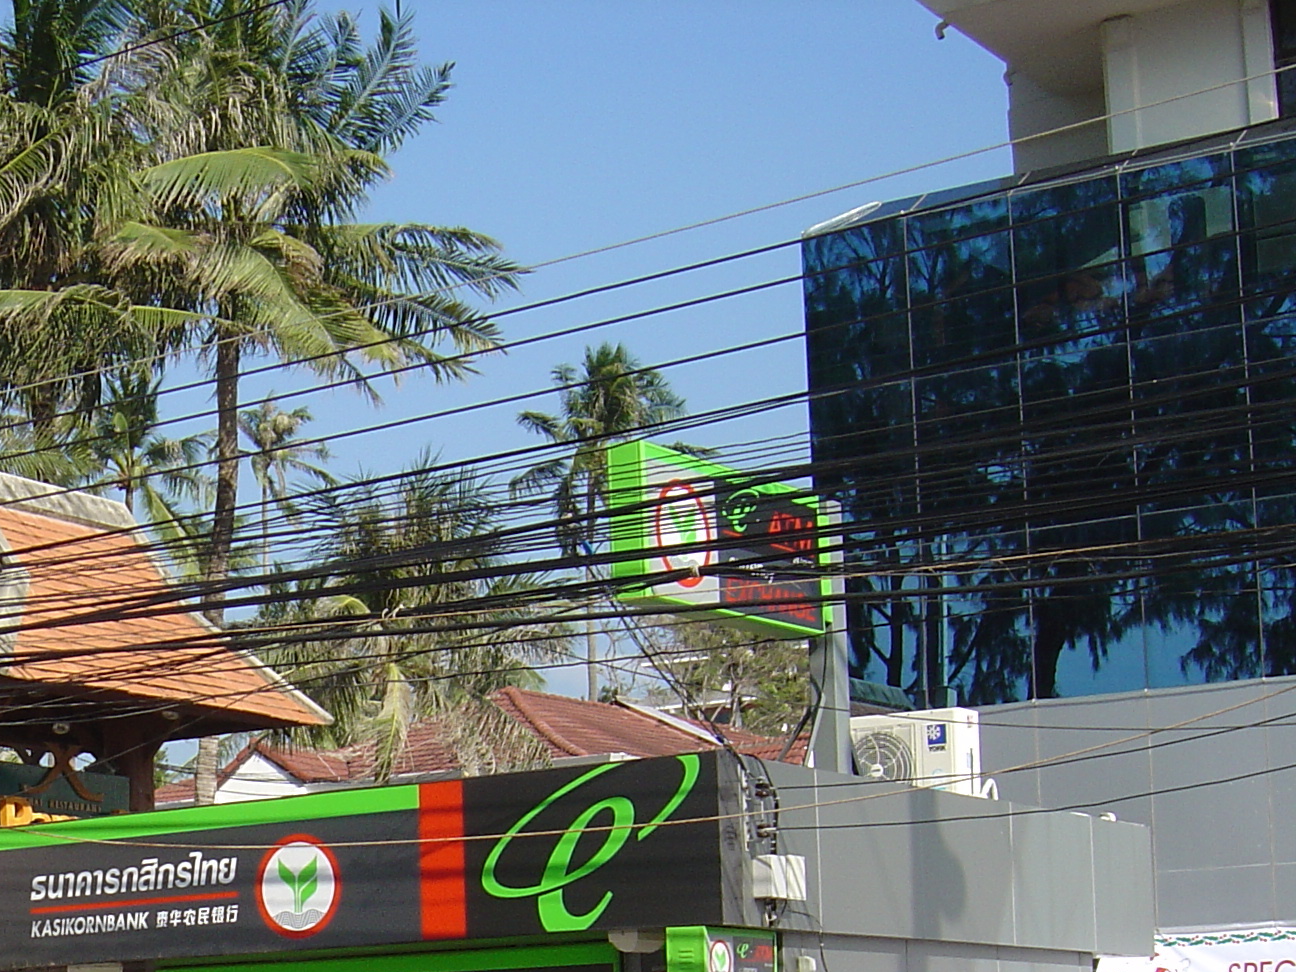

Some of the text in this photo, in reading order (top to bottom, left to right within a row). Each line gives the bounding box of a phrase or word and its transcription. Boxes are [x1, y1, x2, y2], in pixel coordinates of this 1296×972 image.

[30, 851, 237, 901] ธนาคารกสิกรไทย
[31, 911, 150, 938] KASIKORNBANK
